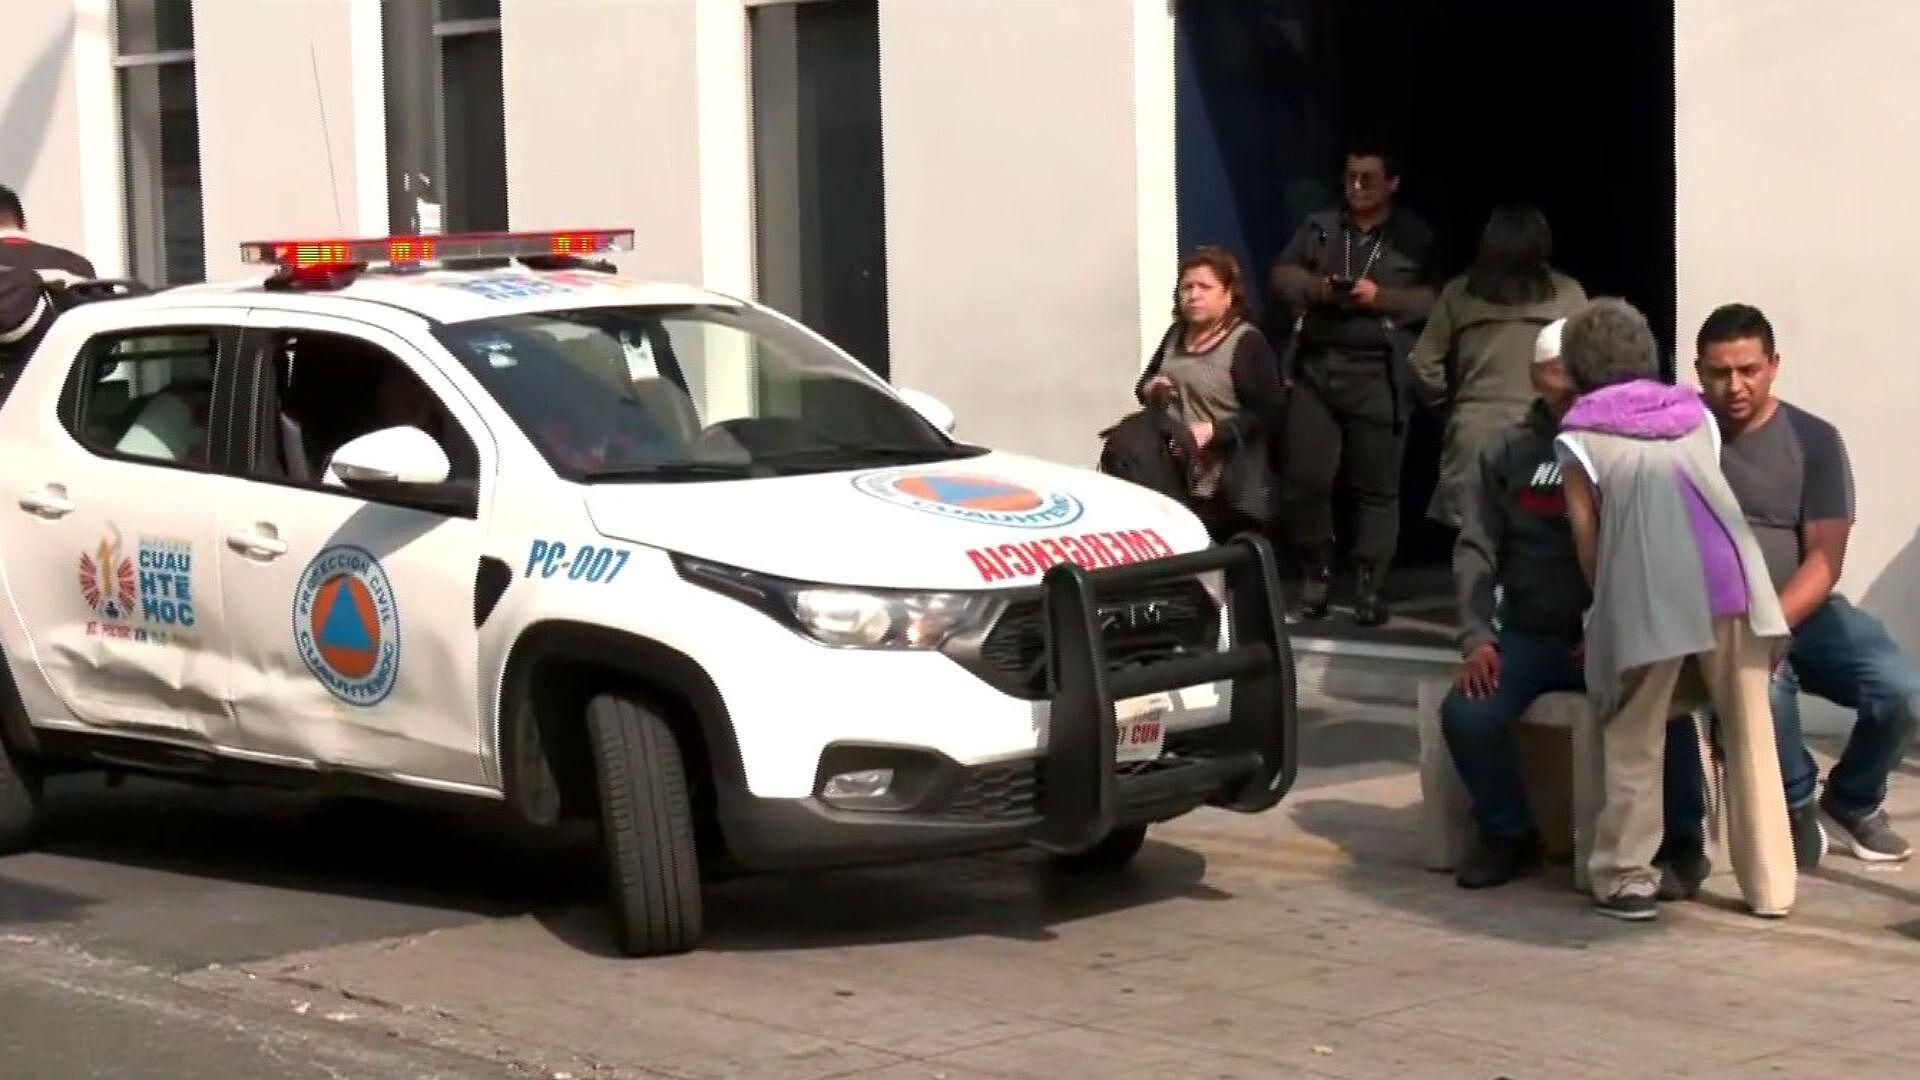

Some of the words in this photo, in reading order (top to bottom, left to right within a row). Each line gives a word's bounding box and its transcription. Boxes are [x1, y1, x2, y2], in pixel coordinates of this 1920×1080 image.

[139, 549, 191, 572] CUAU
[524, 538, 631, 583] PC-007
[139, 571, 192, 602] HTE
[141, 598, 195, 627] MOC
